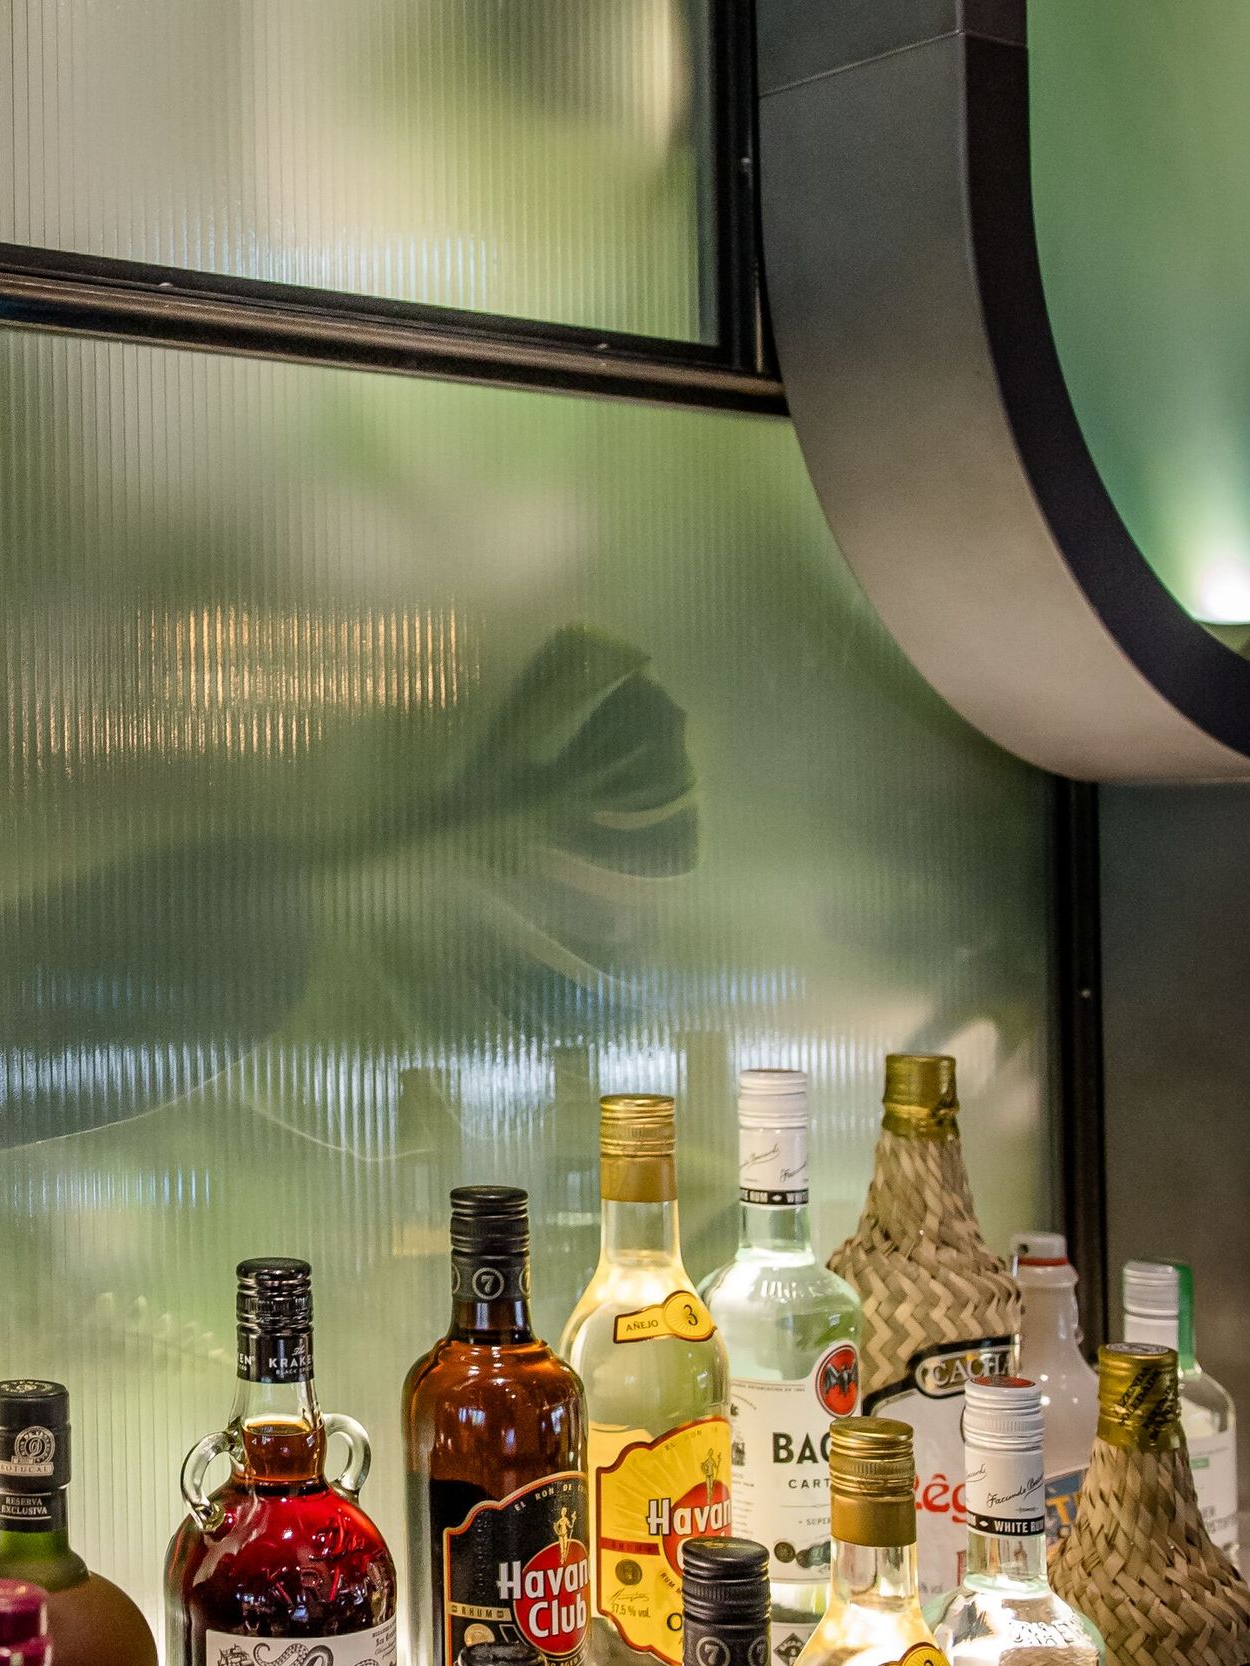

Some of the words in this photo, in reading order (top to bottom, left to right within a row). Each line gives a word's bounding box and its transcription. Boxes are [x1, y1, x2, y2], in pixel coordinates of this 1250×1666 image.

[481, 1275, 496, 1294] 7
[626, 1319, 659, 1332] AÑEJO
[683, 1304, 698, 1326] 3
[5, 1496, 43, 1506] RESERVA
[514, 1501, 526, 1511] EL
[535, 1487, 554, 1500] RON
[1, 1505, 48, 1515] EXCLUSIVA
[994, 1520, 1029, 1533] WHITE
[496, 1558, 589, 1600] Havan
[660, 1572, 677, 1589] RUM
[461, 1605, 493, 1618] RHUM
[528, 1593, 587, 1639] Club
